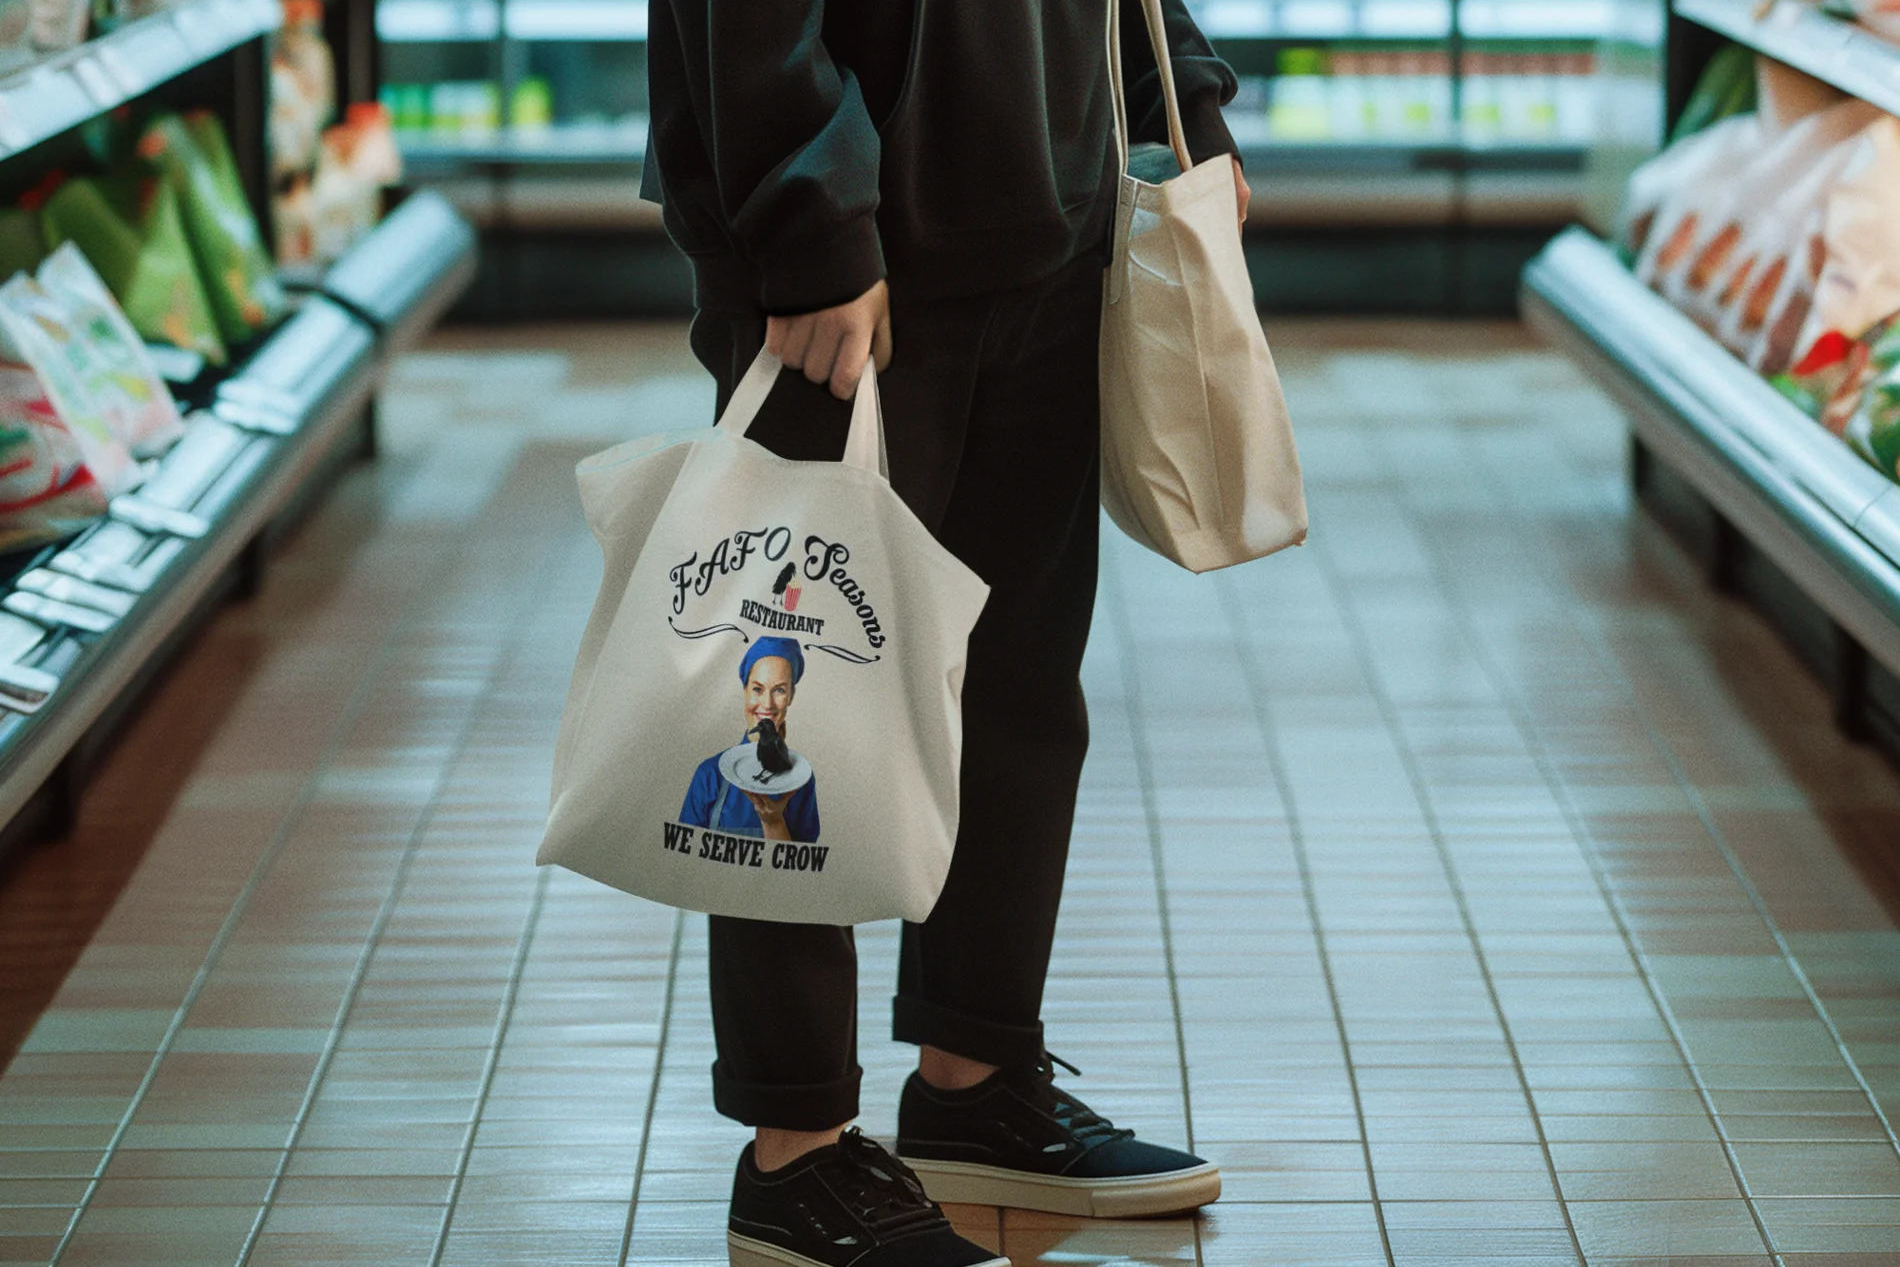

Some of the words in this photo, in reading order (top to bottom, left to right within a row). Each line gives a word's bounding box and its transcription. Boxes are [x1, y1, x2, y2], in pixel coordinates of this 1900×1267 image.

[669, 526, 791, 614] FAFO
[804, 535, 886, 649] Seasons
[739, 599, 825, 636] RESTAURANT
[663, 821, 694, 855] WE
[699, 830, 765, 868] SERVE
[771, 842, 829, 872] CROW
